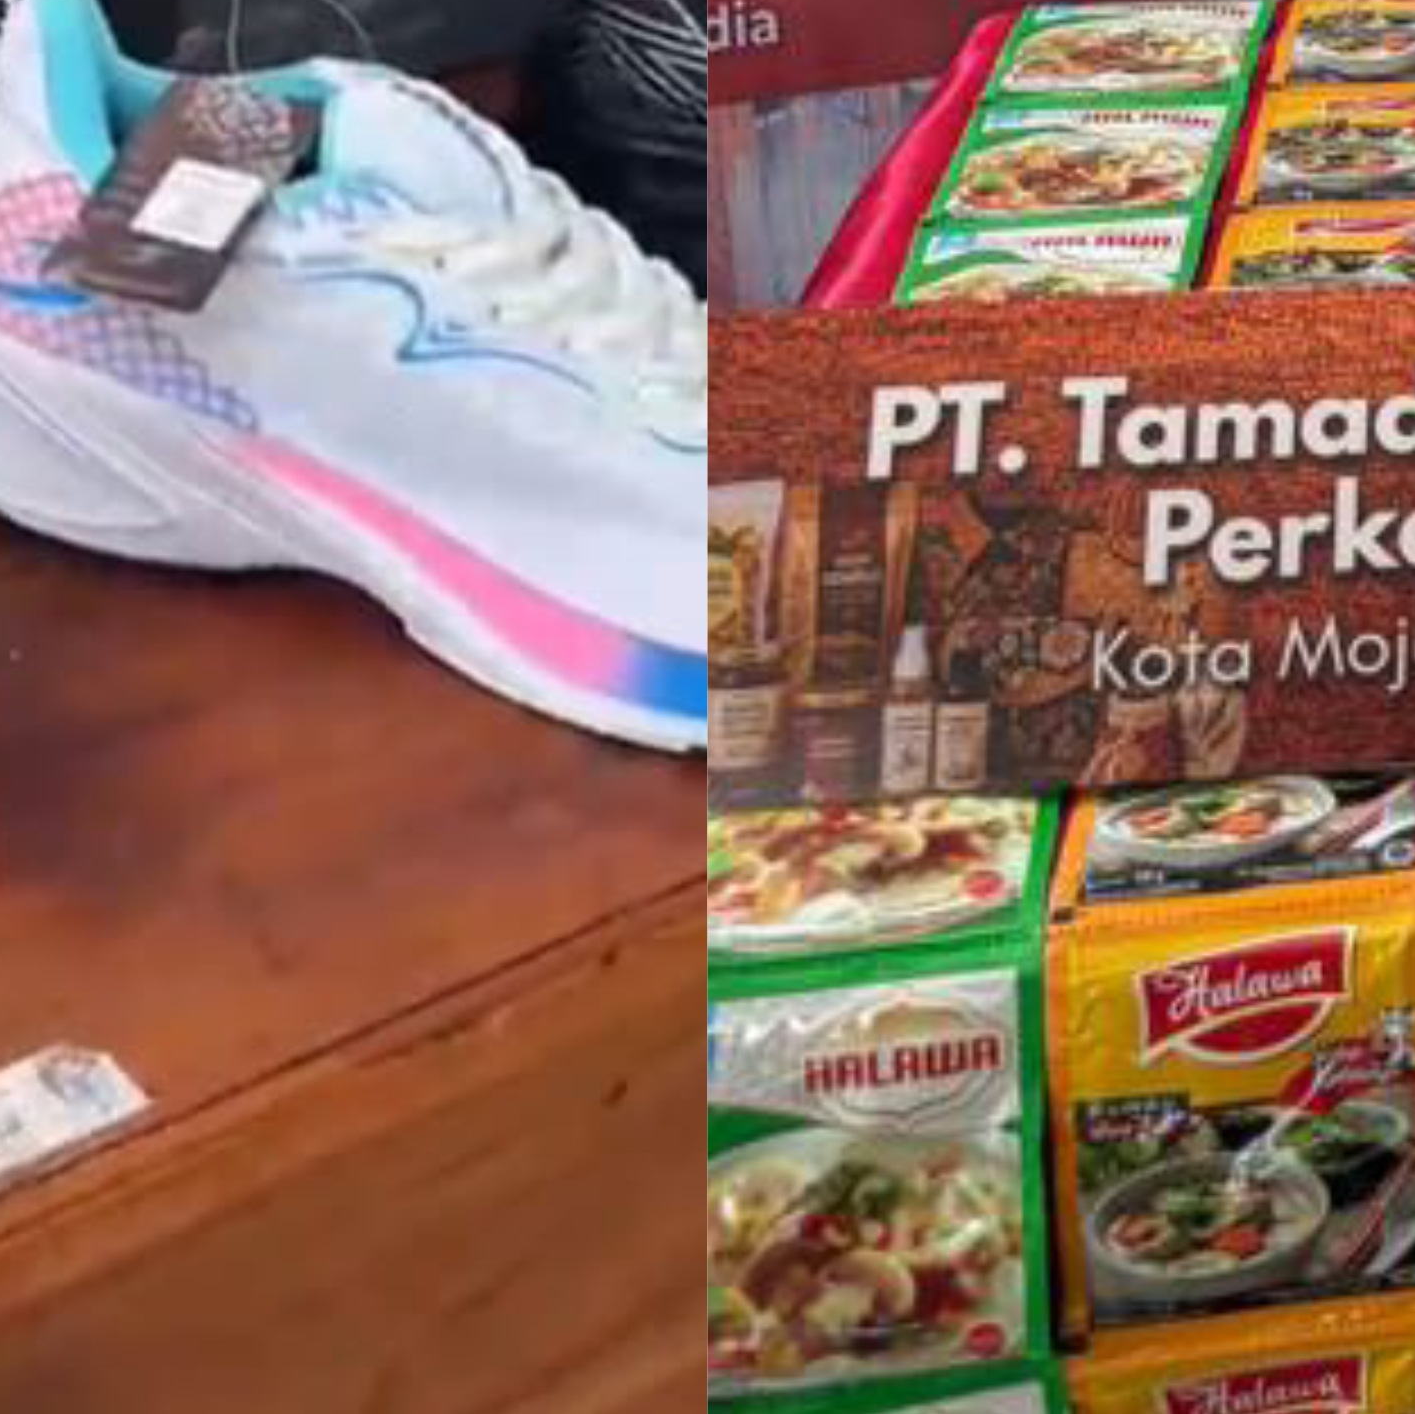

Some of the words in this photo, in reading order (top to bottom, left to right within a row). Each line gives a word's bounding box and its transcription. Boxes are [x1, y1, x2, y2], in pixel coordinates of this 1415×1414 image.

[865, 380, 1028, 481] PT.
[1091, 628, 1252, 694] Kota
[1151, 958, 1324, 1023] Halawa
[804, 1034, 1001, 1094] HALAWA
